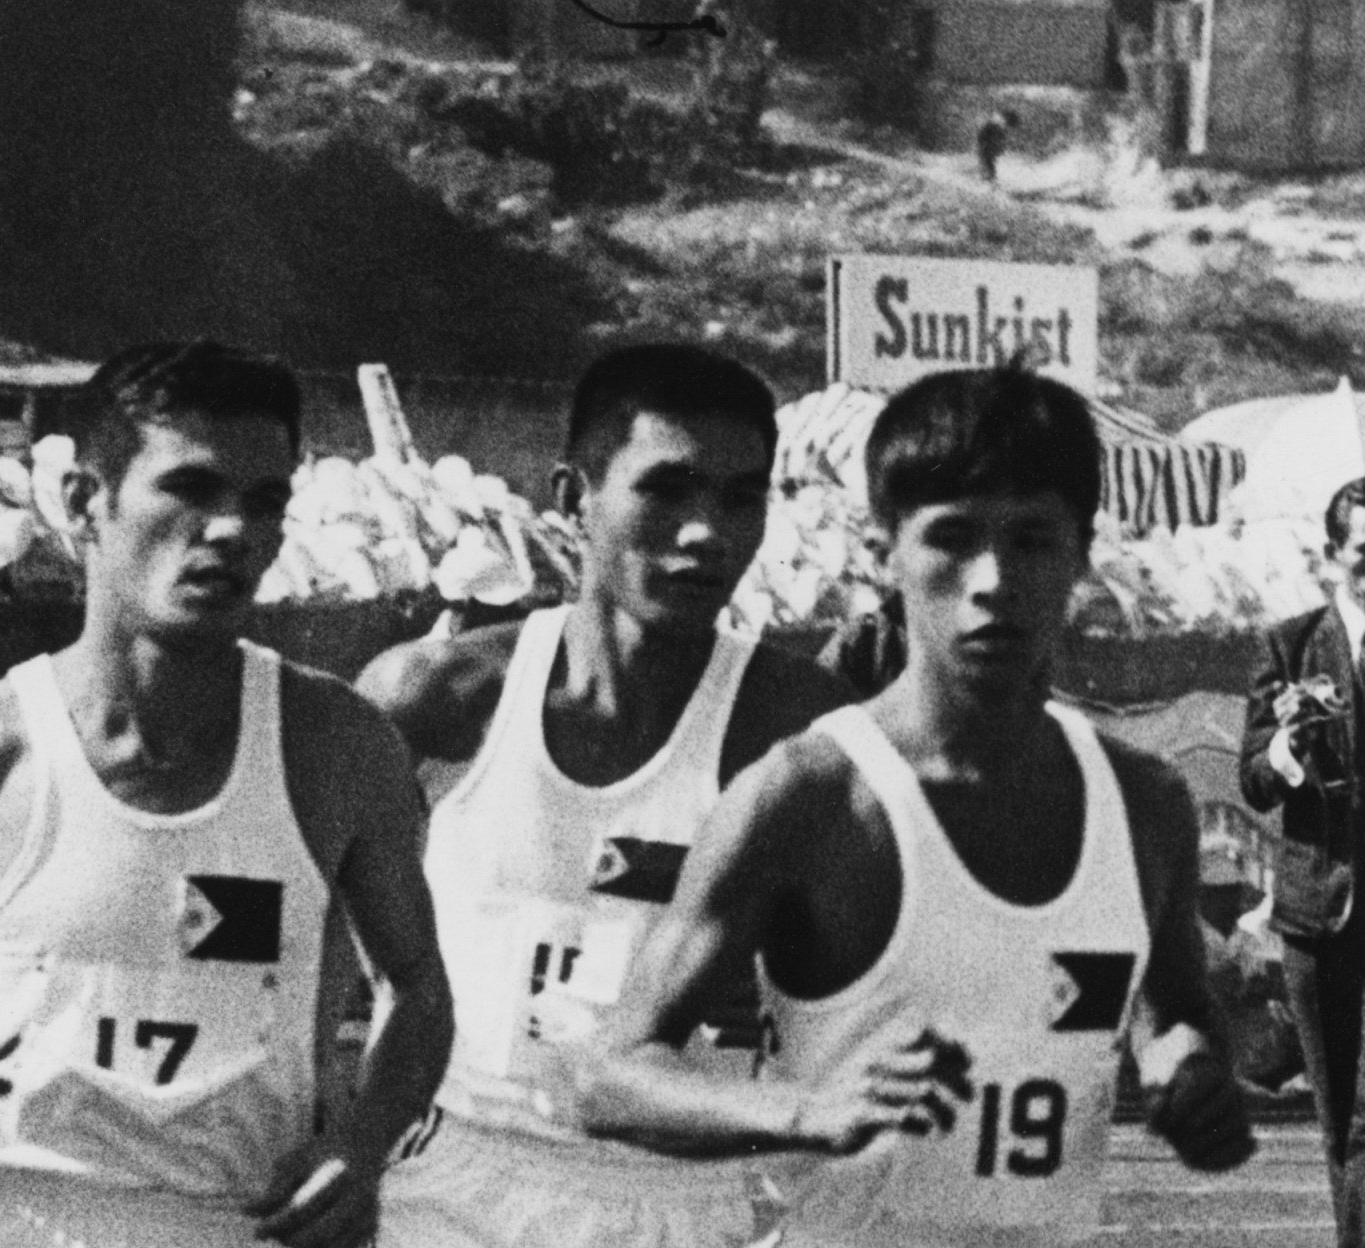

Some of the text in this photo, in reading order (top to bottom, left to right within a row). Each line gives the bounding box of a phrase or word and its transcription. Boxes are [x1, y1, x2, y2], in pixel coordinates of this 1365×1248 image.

[873, 275, 1071, 368] Sunkist
[95, 1016, 199, 1086] 17
[974, 1076, 1068, 1178] 19
